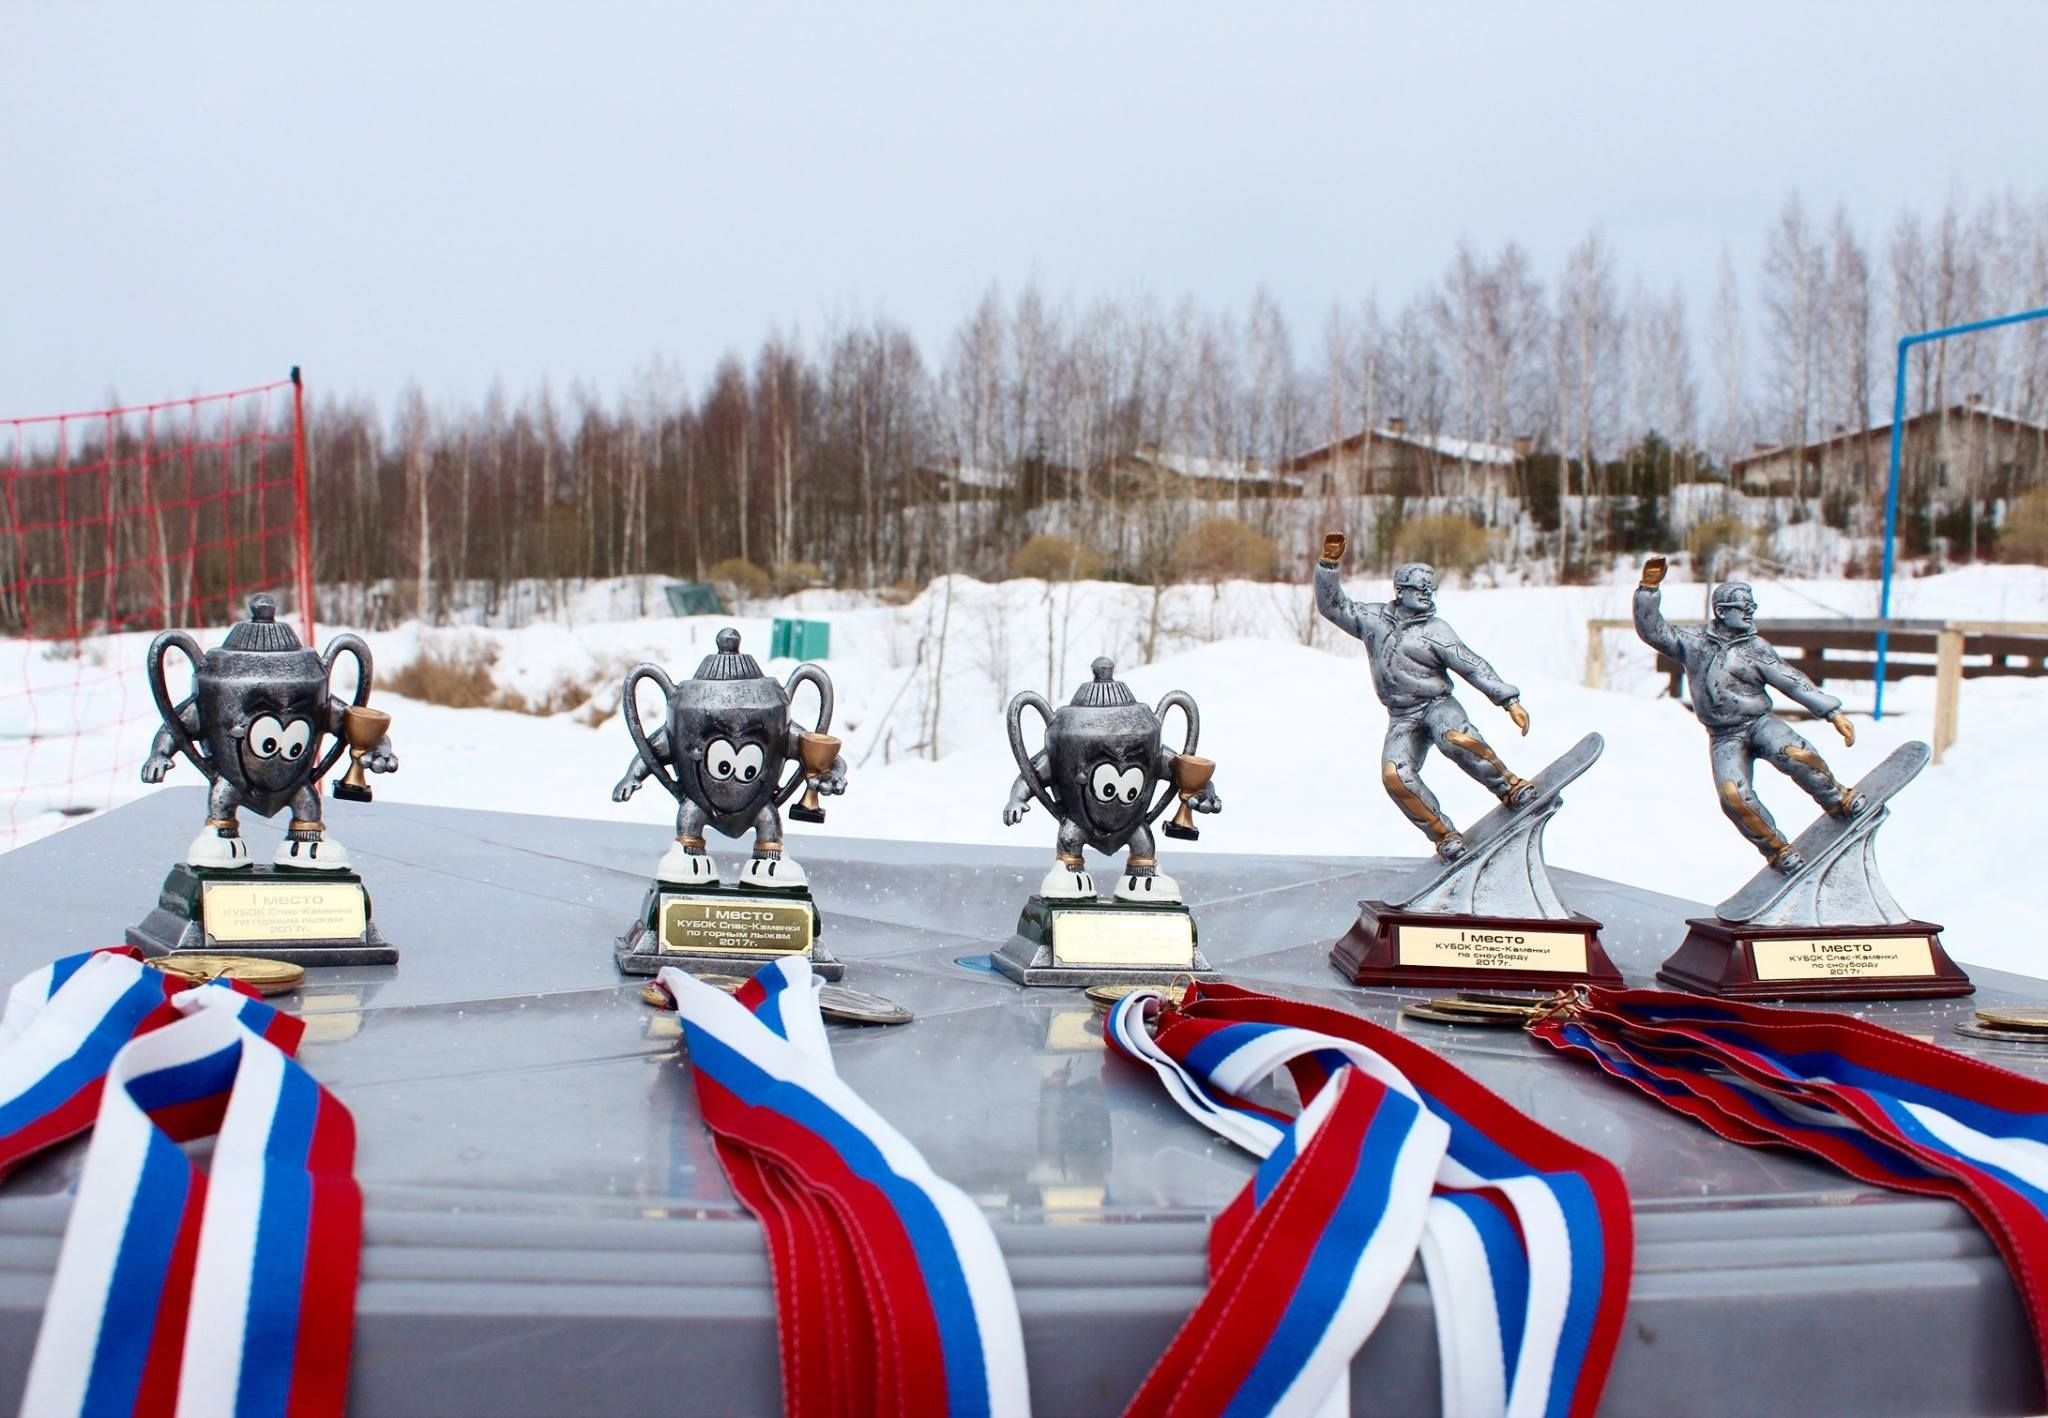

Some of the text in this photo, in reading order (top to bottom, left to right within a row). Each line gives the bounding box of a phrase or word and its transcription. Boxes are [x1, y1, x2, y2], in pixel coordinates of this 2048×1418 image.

[716, 909, 774, 921] место
[677, 919, 800, 932] КУБОК Спас-Каменки
[703, 930, 748, 939] горным
[750, 932, 791, 940] лыжам
[1471, 934, 1525, 944] место
[719, 938, 758, 947] 2017г.
[1435, 943, 1551, 954] КУБОК Спас-Каменки
[1821, 944, 1872, 953] место
[1473, 952, 1529, 961] сноуборду
[1789, 954, 1824, 962] КУБОК
[1475, 959, 1512, 967] 2017г.
